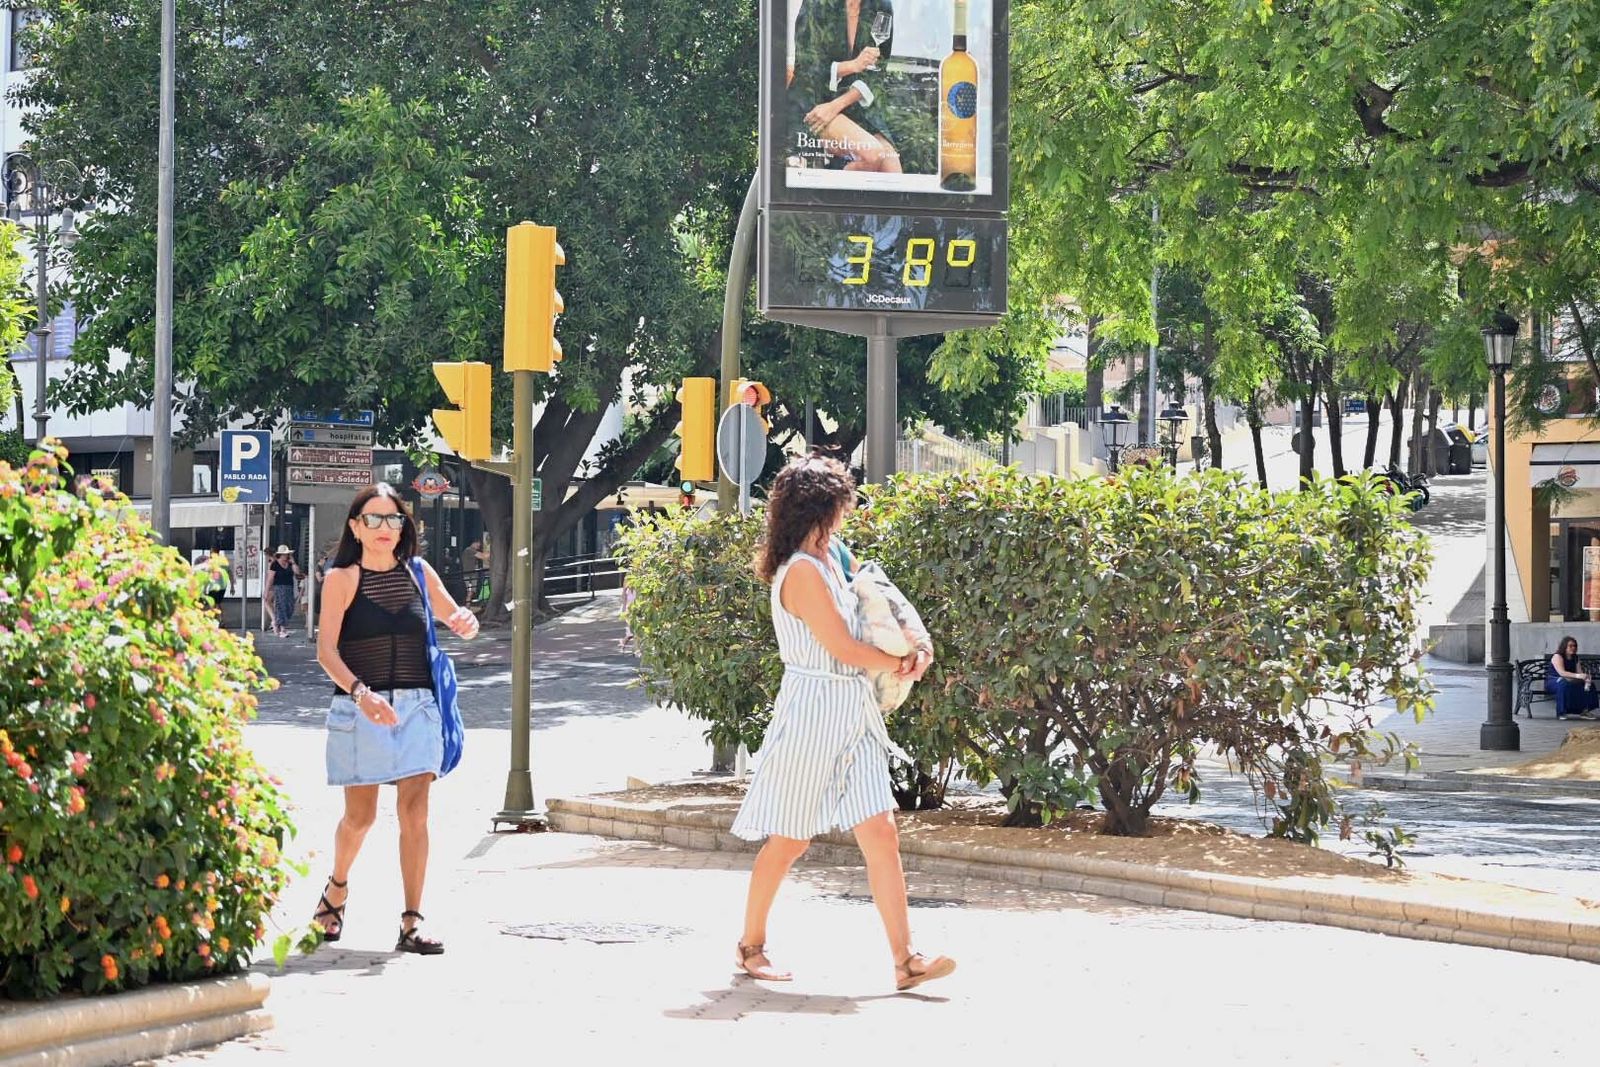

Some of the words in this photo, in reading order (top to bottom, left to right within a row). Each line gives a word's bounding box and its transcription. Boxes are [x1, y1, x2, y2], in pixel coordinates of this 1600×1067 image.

[865, 294, 912, 304] JCDecaux
[330, 431, 370, 442] hospitales
[231, 434, 260, 471] P
[340, 455, 370, 464] Carmen
[338, 475, 370, 484] Soledad
